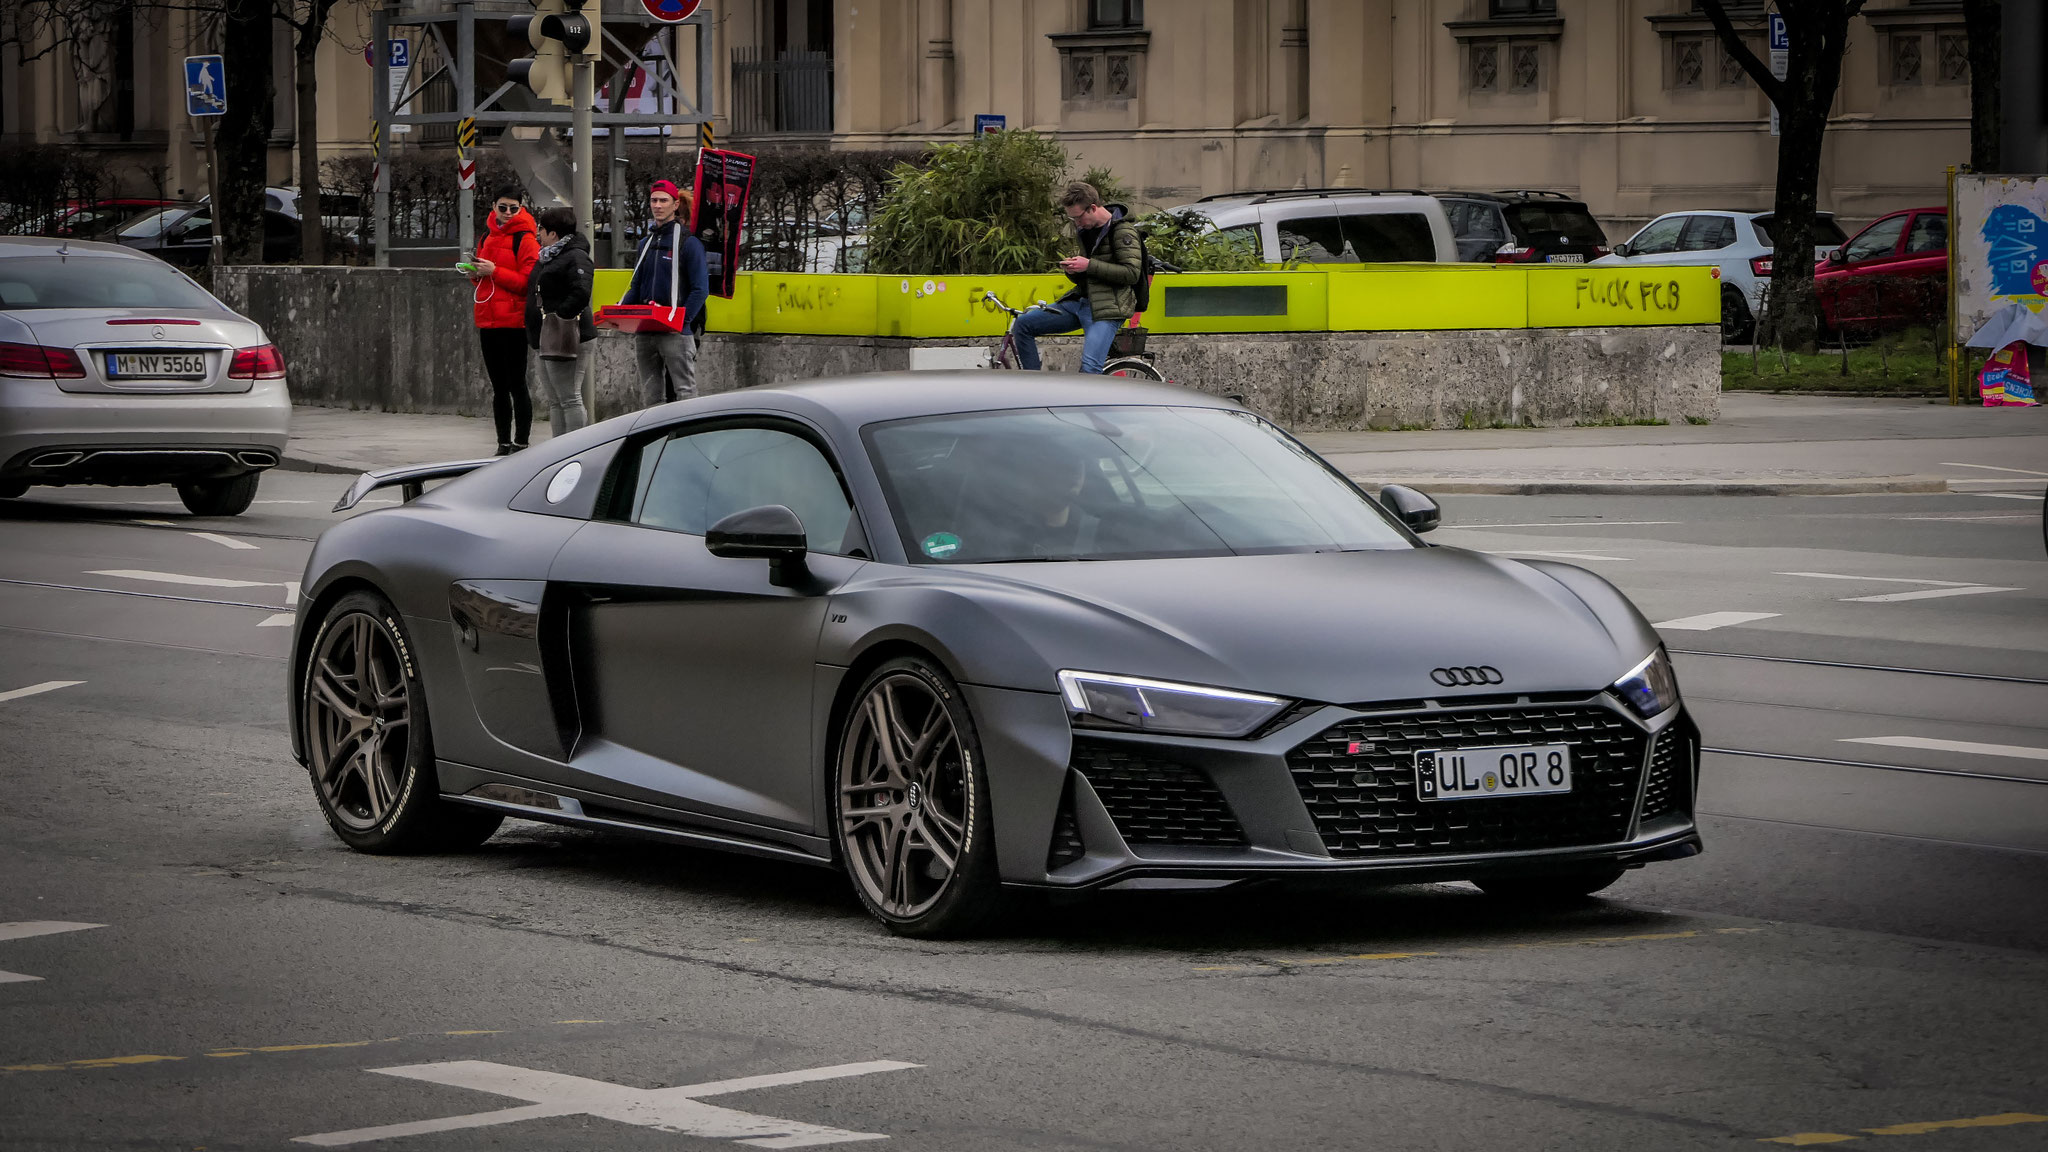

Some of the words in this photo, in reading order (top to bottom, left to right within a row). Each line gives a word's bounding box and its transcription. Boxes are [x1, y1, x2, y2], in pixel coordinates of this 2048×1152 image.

[1774, 17, 1787, 46] P
[392, 42, 405, 65] P
[1639, 280, 1680, 311] FCB
[117, 356, 129, 373] M
[138, 356, 159, 373] NY
[163, 356, 203, 373] 5566
[1424, 780, 1433, 793] D
[1438, 756, 1480, 791] UL
[1500, 752, 1540, 788] QR
[1547, 751, 1564, 786] 8
